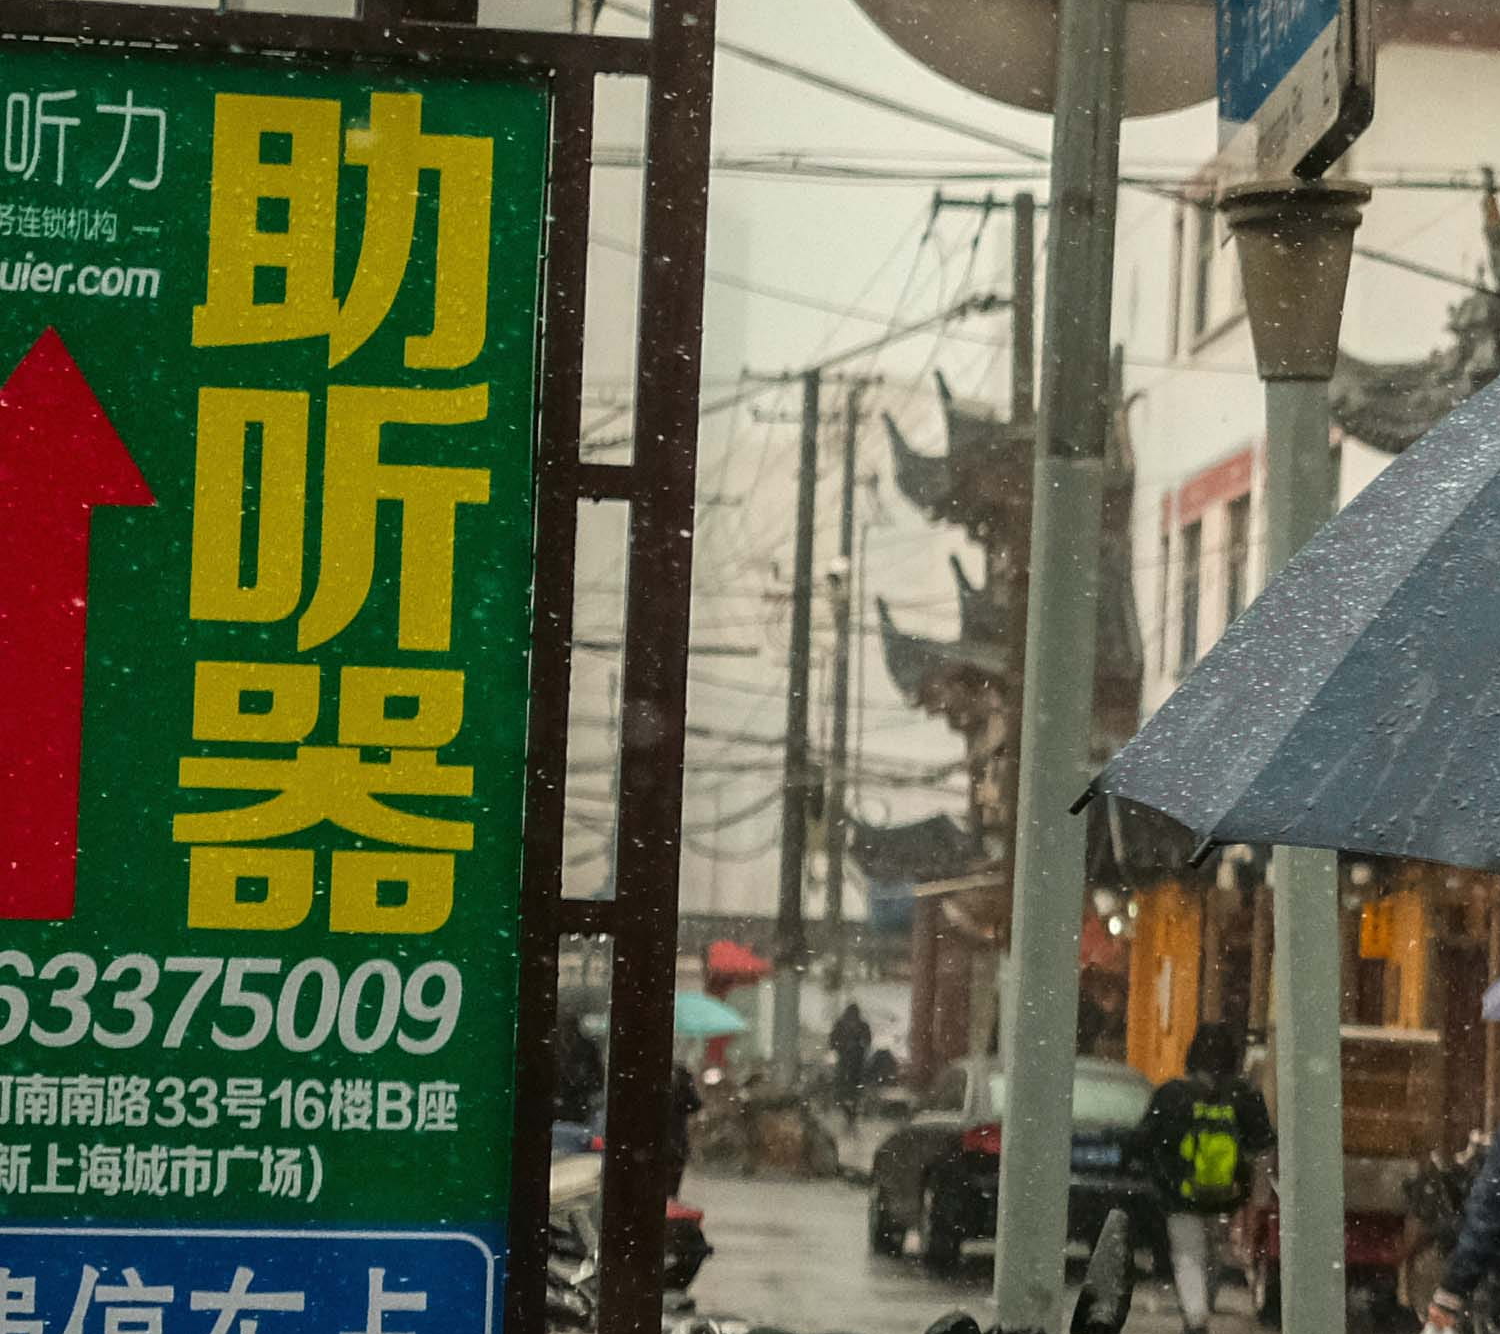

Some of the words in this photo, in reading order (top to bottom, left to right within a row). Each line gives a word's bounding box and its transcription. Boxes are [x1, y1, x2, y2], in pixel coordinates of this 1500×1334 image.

[4, 88, 167, 191] 听力
[172, 92, 494, 935] 助听器
[0, 1073, 461, 1132] 南南路33号16楼B座
